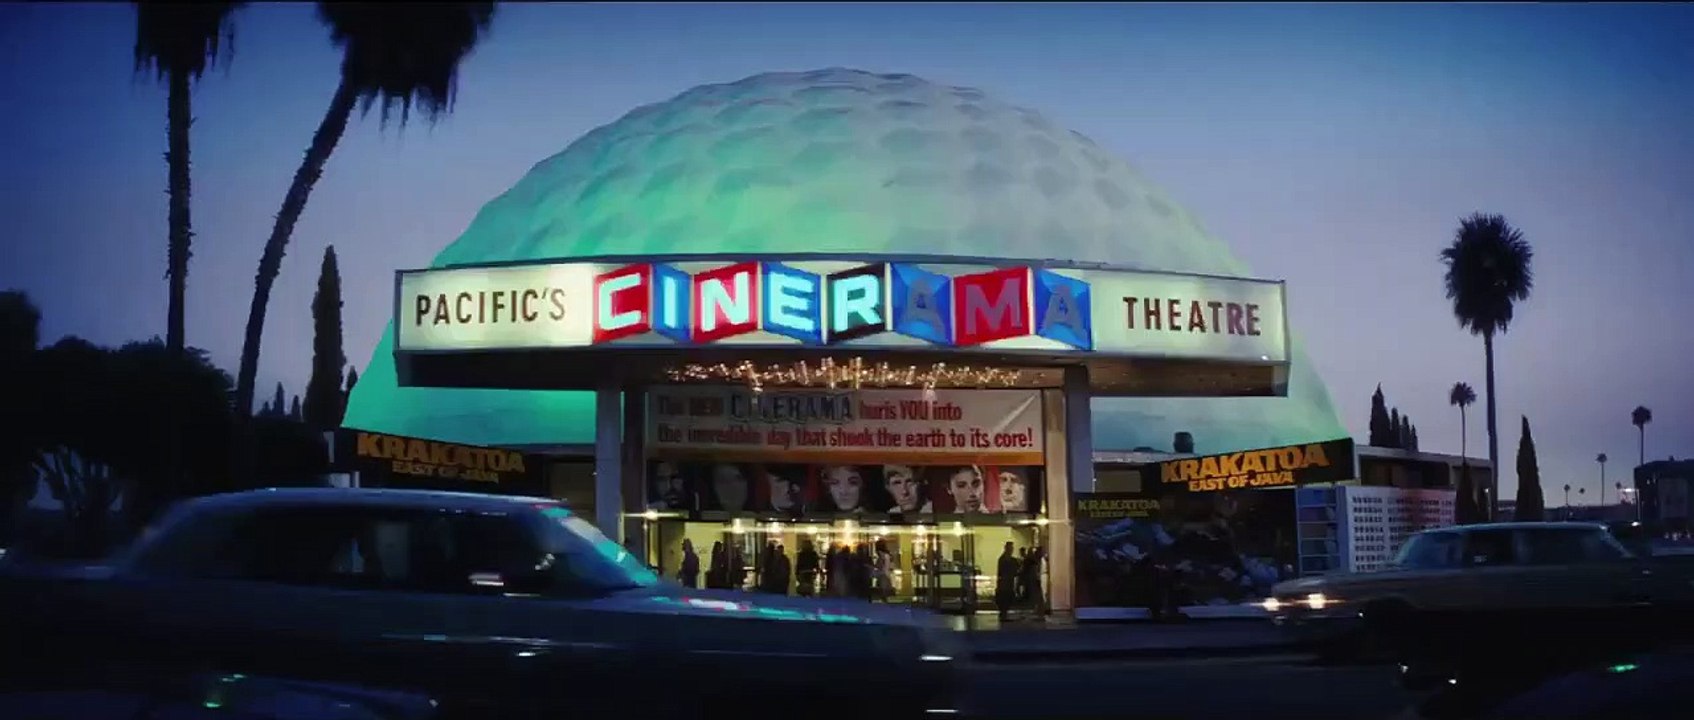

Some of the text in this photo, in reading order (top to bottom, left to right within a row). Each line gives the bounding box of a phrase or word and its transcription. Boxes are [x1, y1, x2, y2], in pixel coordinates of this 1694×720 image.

[416, 268, 1262, 342] PACIFIC'S CINERAMA THEATRE
[900, 399, 929, 420] YOU
[932, 400, 963, 420] into
[878, 427, 902, 447] the
[906, 428, 946, 448] earth
[951, 428, 966, 448] to
[970, 427, 991, 448] its
[994, 426, 1034, 448] core!
[1160, 444, 1331, 483] KRAKATOA
[1188, 471, 1294, 492] EAST OF JAVA
